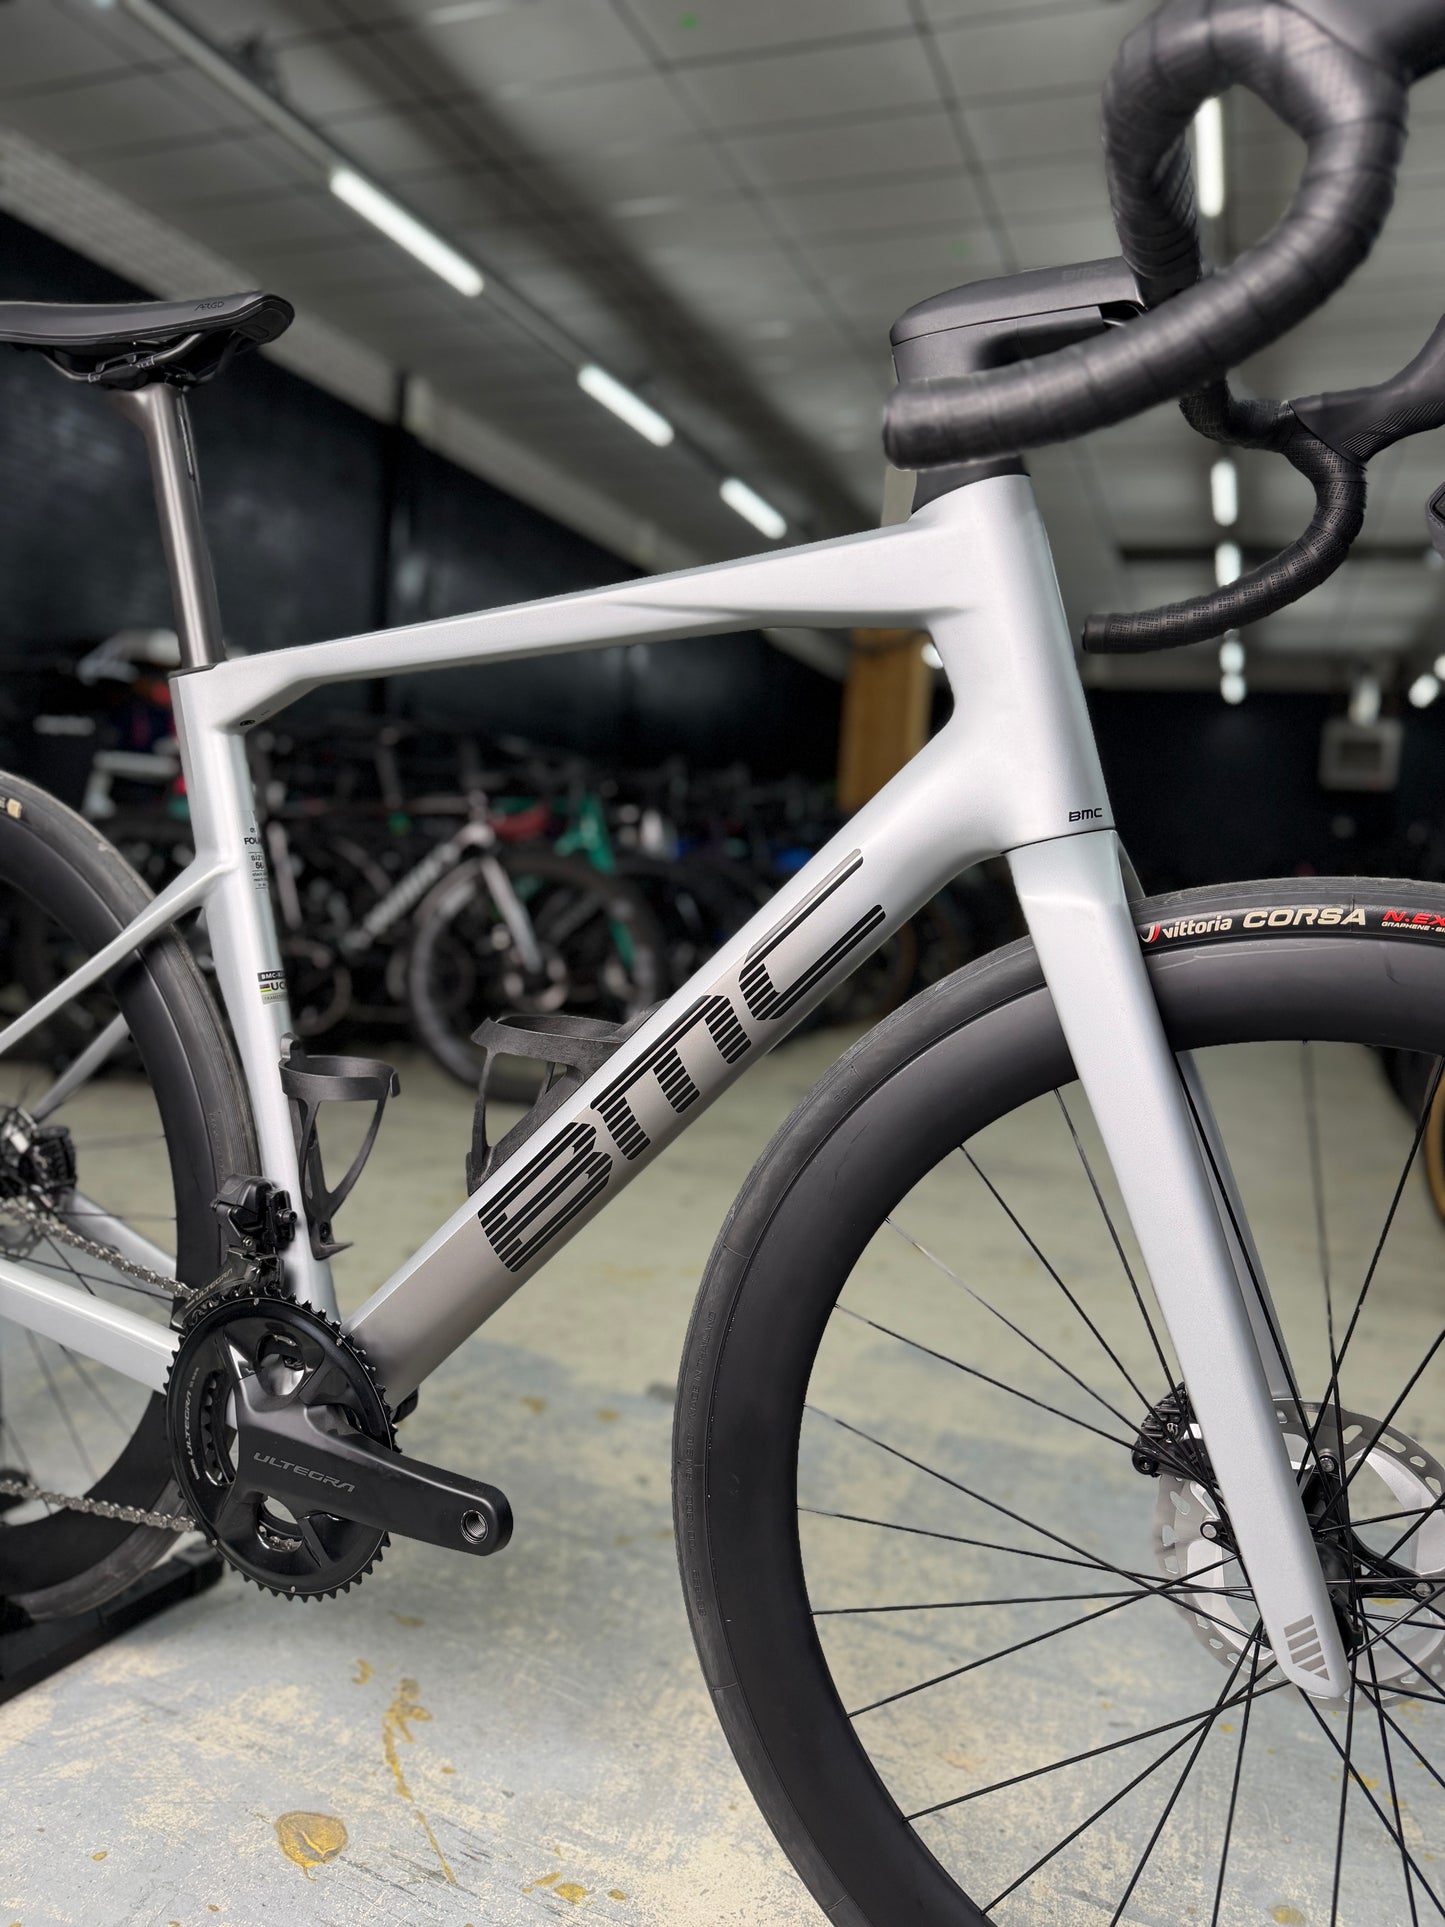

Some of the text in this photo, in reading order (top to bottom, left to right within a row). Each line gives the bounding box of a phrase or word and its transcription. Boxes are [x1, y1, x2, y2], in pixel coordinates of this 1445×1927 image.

[1069, 807, 1102, 822] BMC
[1163, 914, 1232, 939] vittoria
[1243, 908, 1366, 929] CORSA
[270, 981, 287, 991] UC
[195, 1267, 233, 1300] ULTEGRA
[184, 1390, 193, 1455] ULTEGRA
[253, 1452, 356, 1493] ULTEGRA
